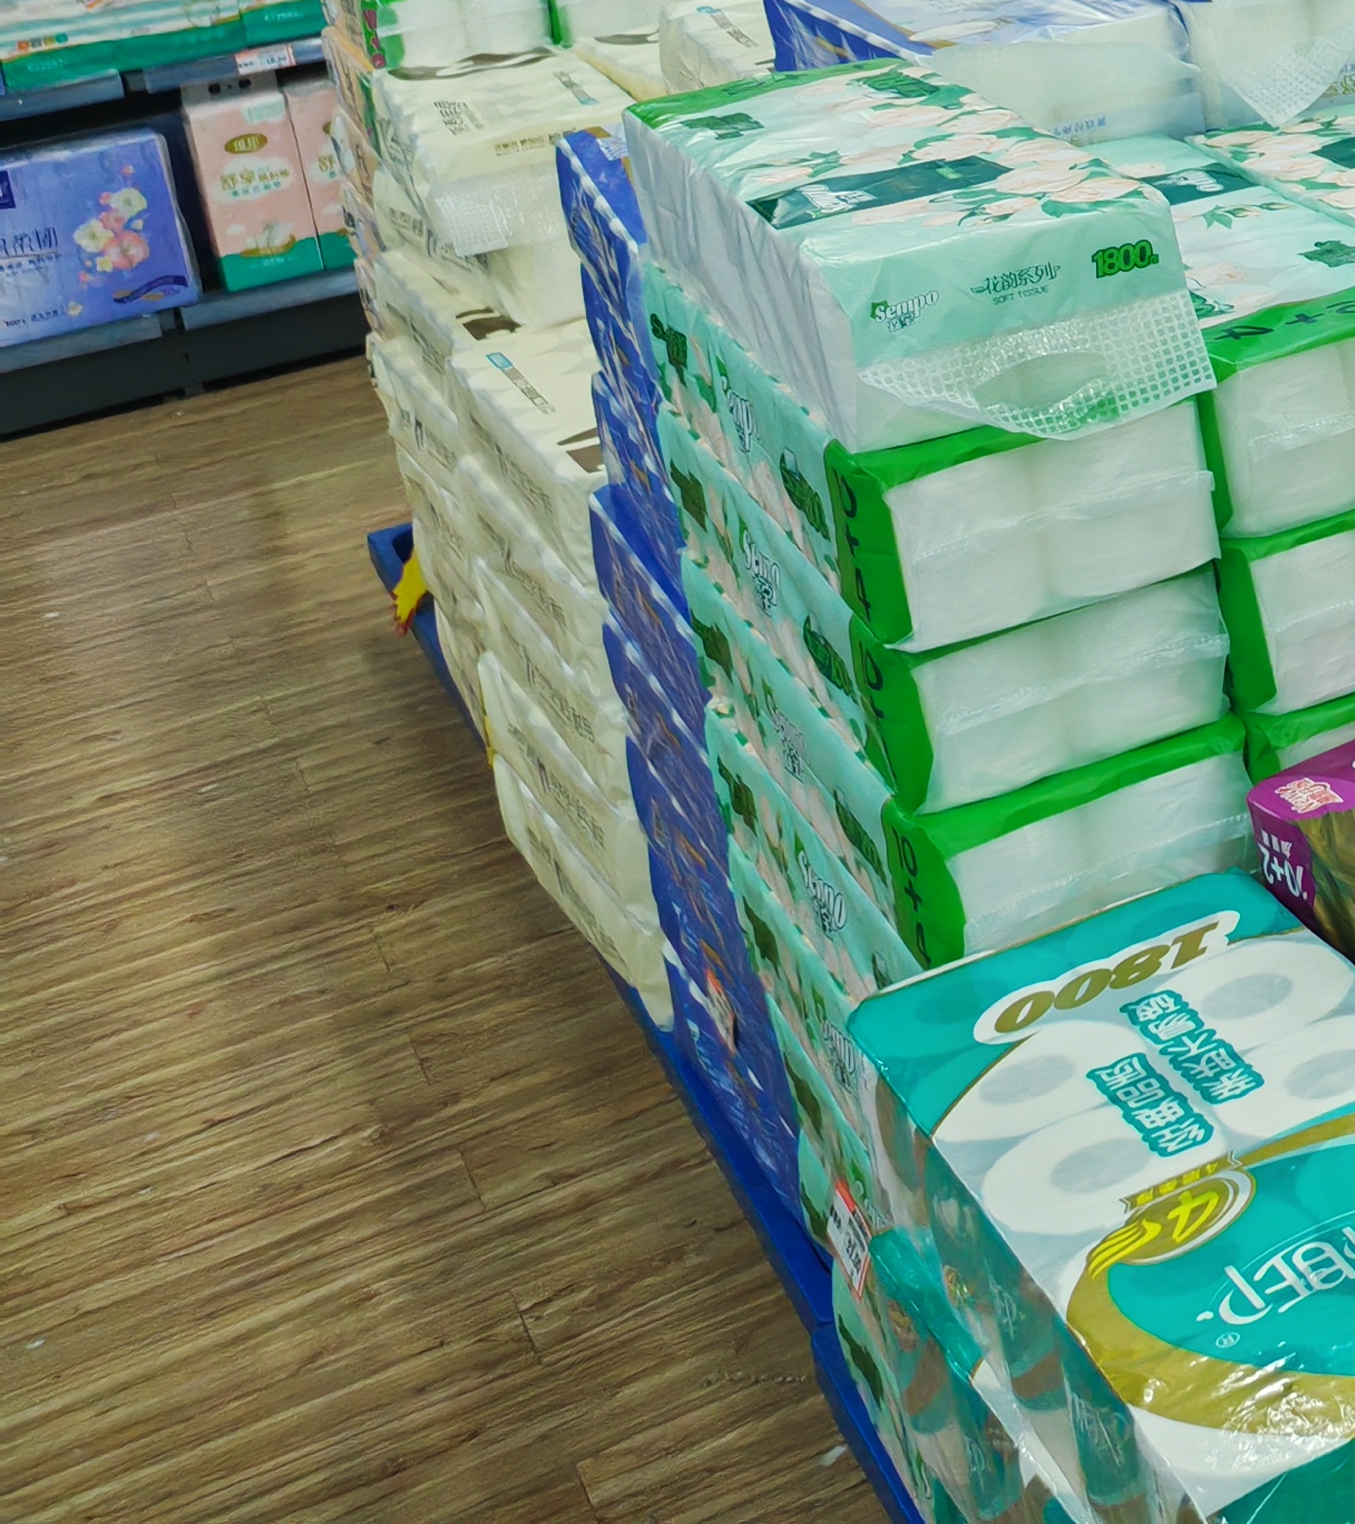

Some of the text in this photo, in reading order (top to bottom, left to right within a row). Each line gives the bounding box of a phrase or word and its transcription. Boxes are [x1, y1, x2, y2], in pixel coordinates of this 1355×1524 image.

[994, 921, 1219, 1036] 1800
[1094, 1056, 1206, 1154] 经典品质
